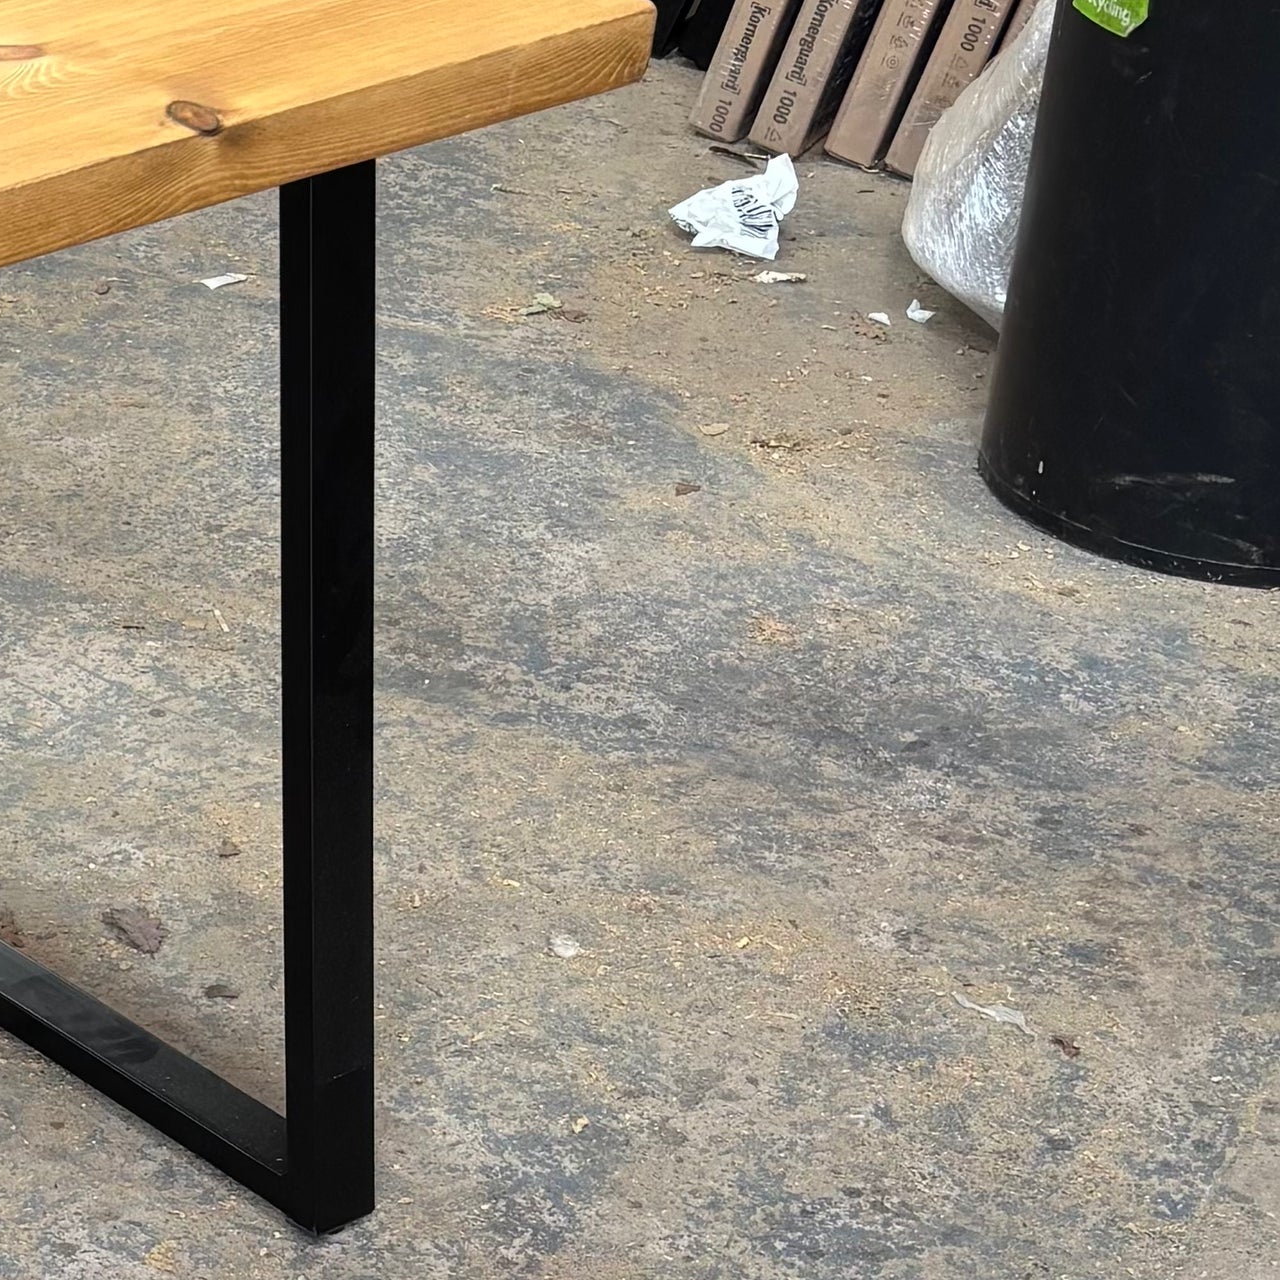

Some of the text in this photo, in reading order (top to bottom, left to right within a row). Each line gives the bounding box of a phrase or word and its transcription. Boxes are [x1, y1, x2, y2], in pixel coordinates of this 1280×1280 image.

[960, 16, 986, 52] 1000
[709, 98, 732, 133] 1000
[773, 89, 797, 124] 1000
